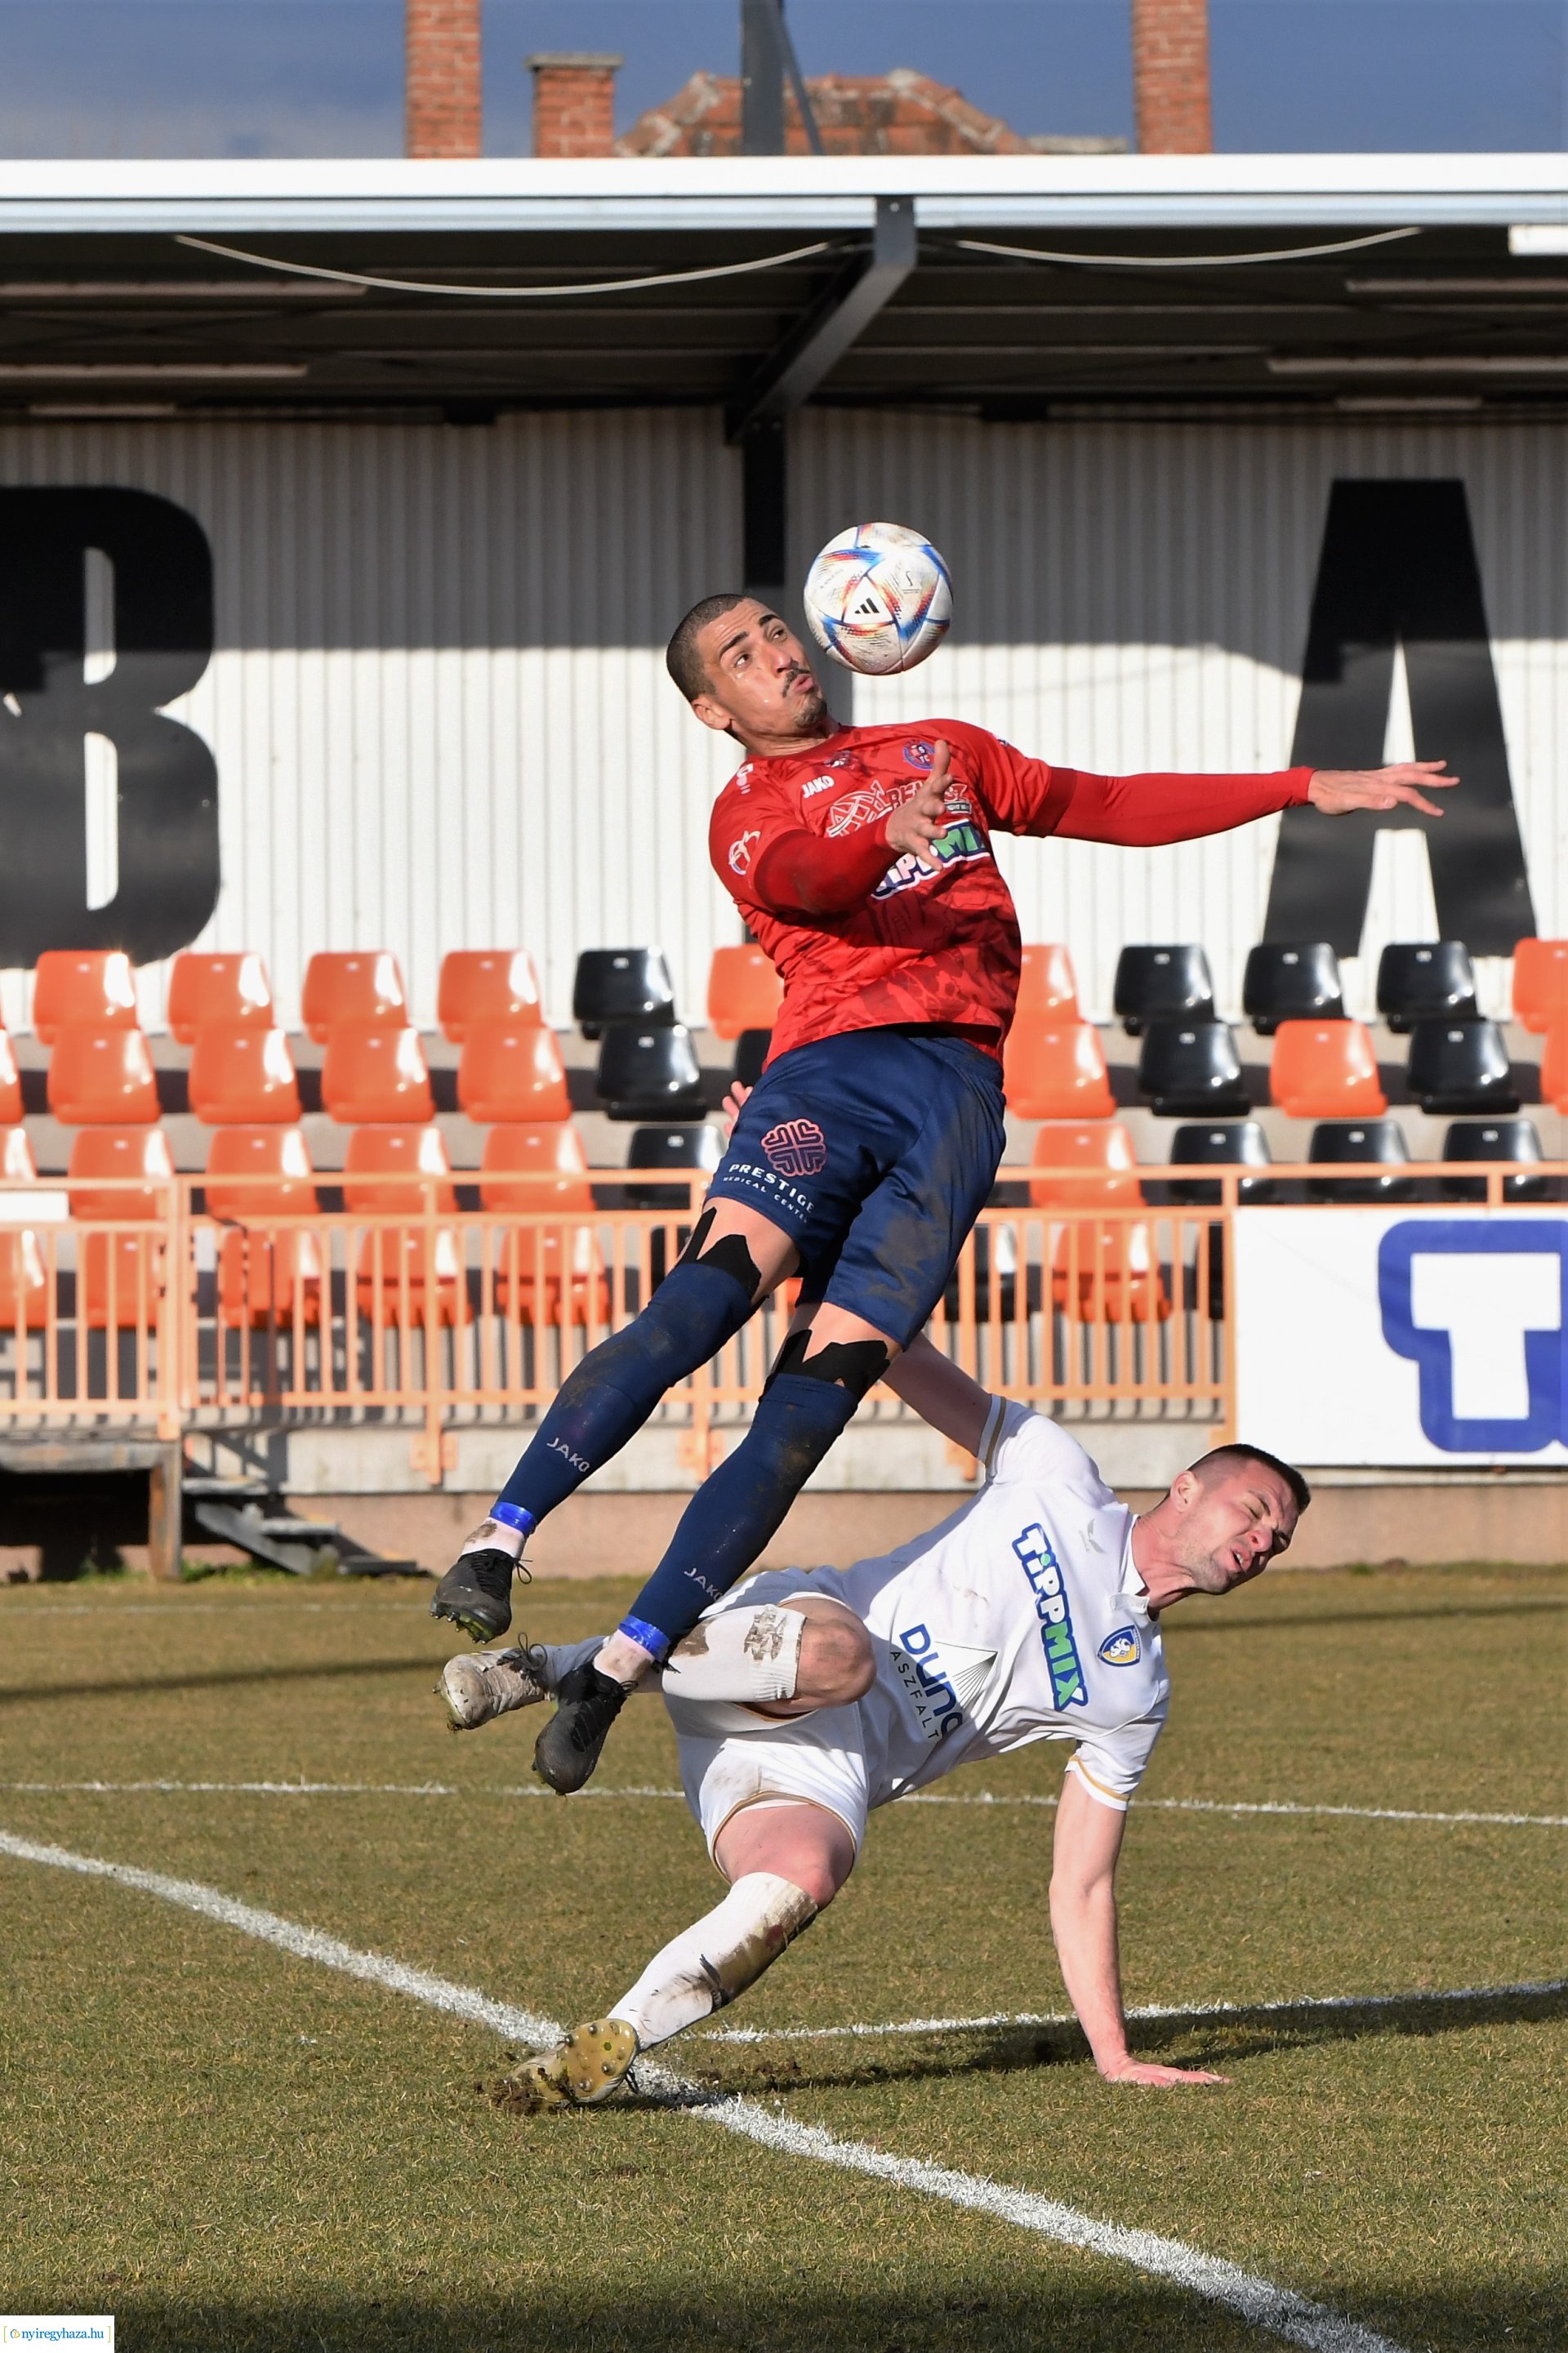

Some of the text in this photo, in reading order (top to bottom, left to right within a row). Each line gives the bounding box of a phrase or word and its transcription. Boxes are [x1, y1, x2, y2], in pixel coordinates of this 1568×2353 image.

[1263, 478, 1537, 956] A
[801, 774, 835, 799] JAKO
[723, 1175, 767, 1192] MEDICAL
[728, 1163, 815, 1214] PRESTIGE
[546, 1437, 590, 1473] JAKO
[889, 1651, 940, 1740] ASZFALT
